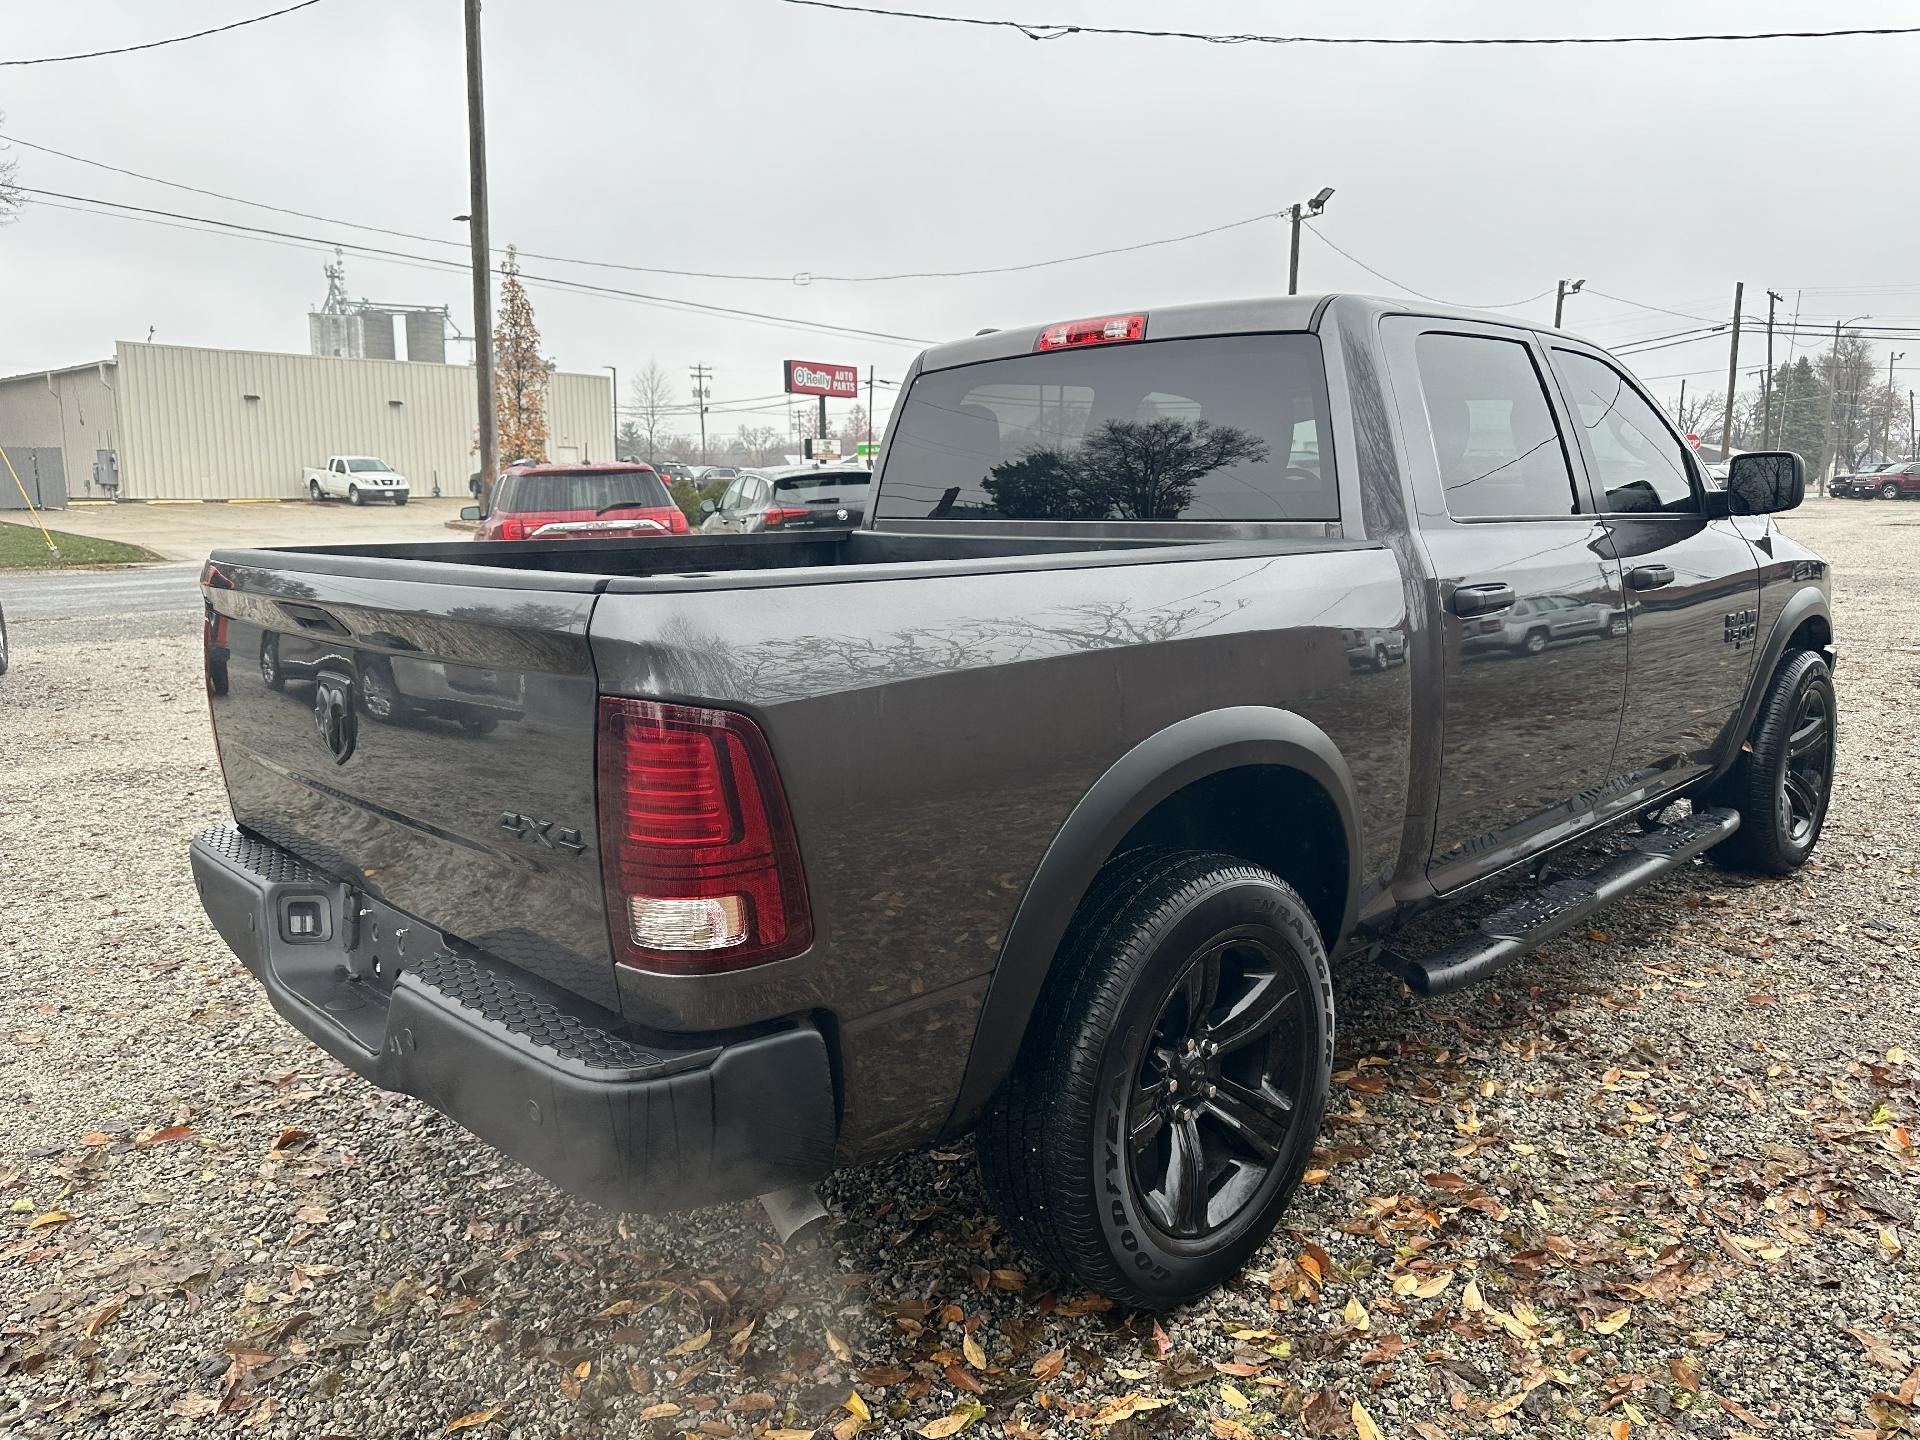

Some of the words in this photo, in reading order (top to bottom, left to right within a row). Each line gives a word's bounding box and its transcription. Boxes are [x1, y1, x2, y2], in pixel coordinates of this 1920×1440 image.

[794, 367, 831, 389] O'Reilly
[835, 371, 853, 381] AUTO
[833, 381, 855, 392] PARTS
[1725, 608, 1757, 628] RAM
[1724, 624, 1756, 643] 1500
[1254, 898, 1334, 1068] WRANGLER
